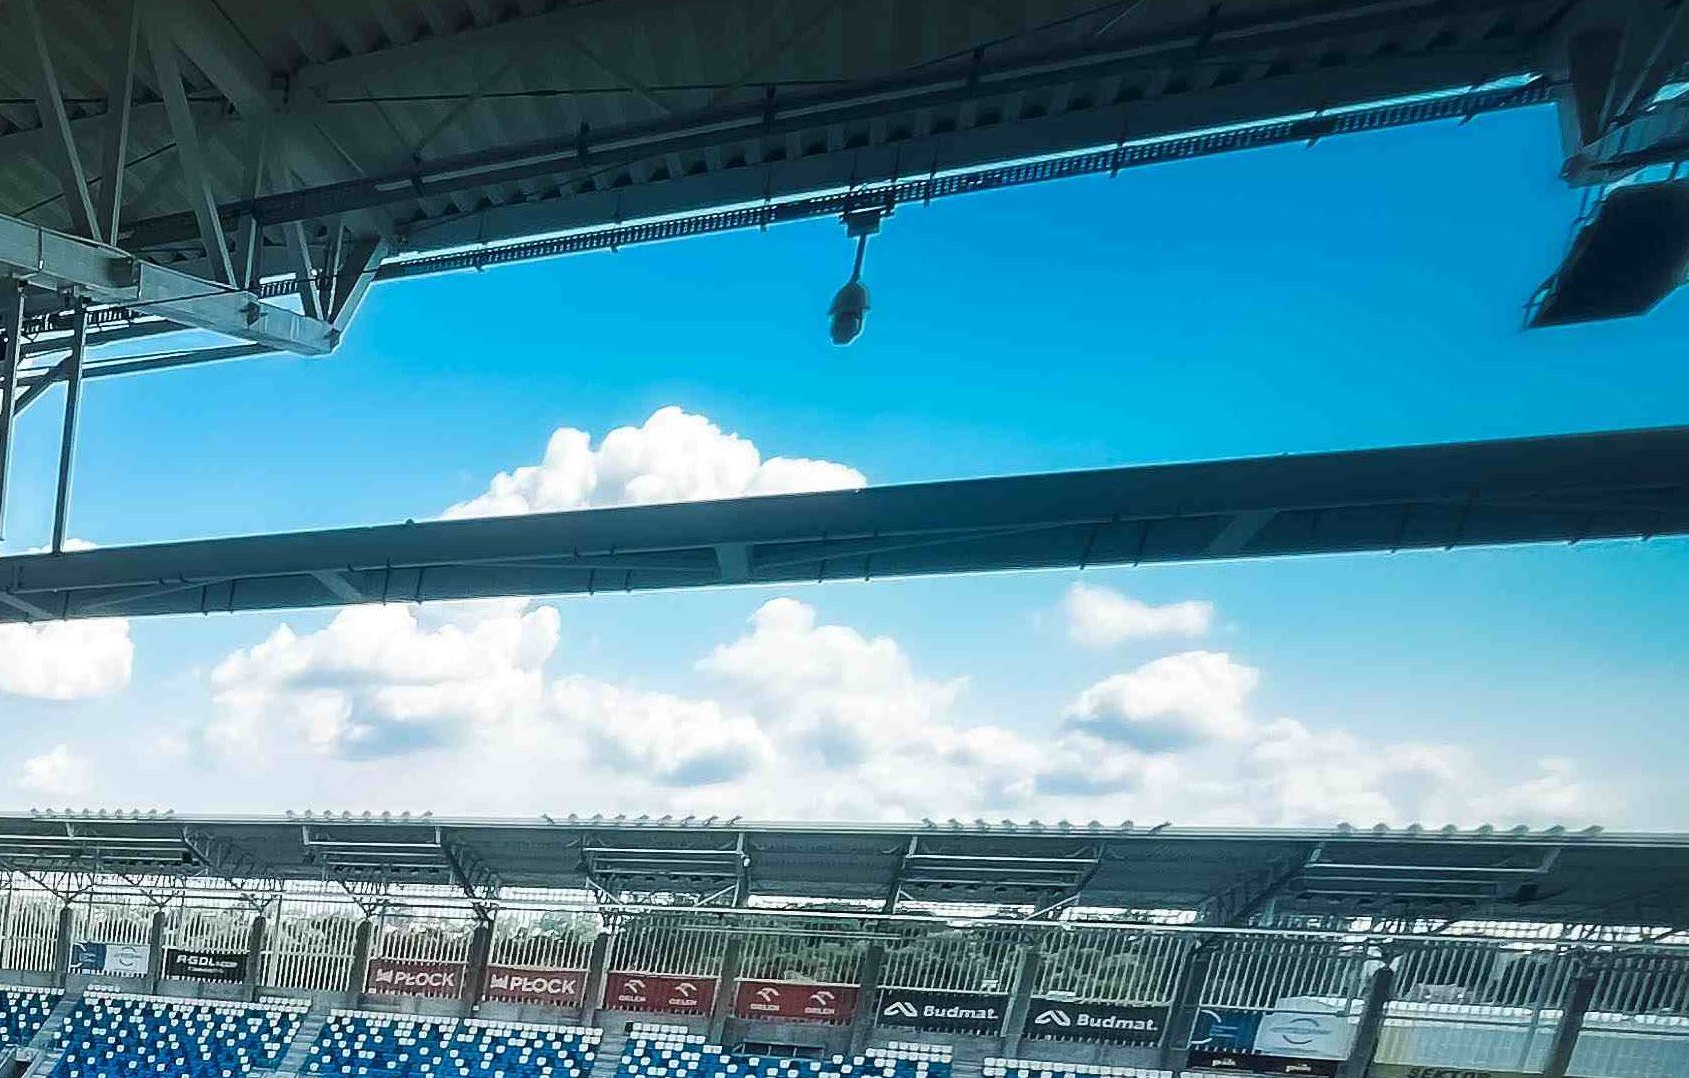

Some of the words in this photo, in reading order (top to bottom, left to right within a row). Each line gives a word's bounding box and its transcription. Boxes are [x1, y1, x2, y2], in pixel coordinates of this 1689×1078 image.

[394, 971, 455, 988] PŁOCK
[509, 976, 577, 995] PŁOCK
[1076, 1014, 1158, 1031] Budmat.
